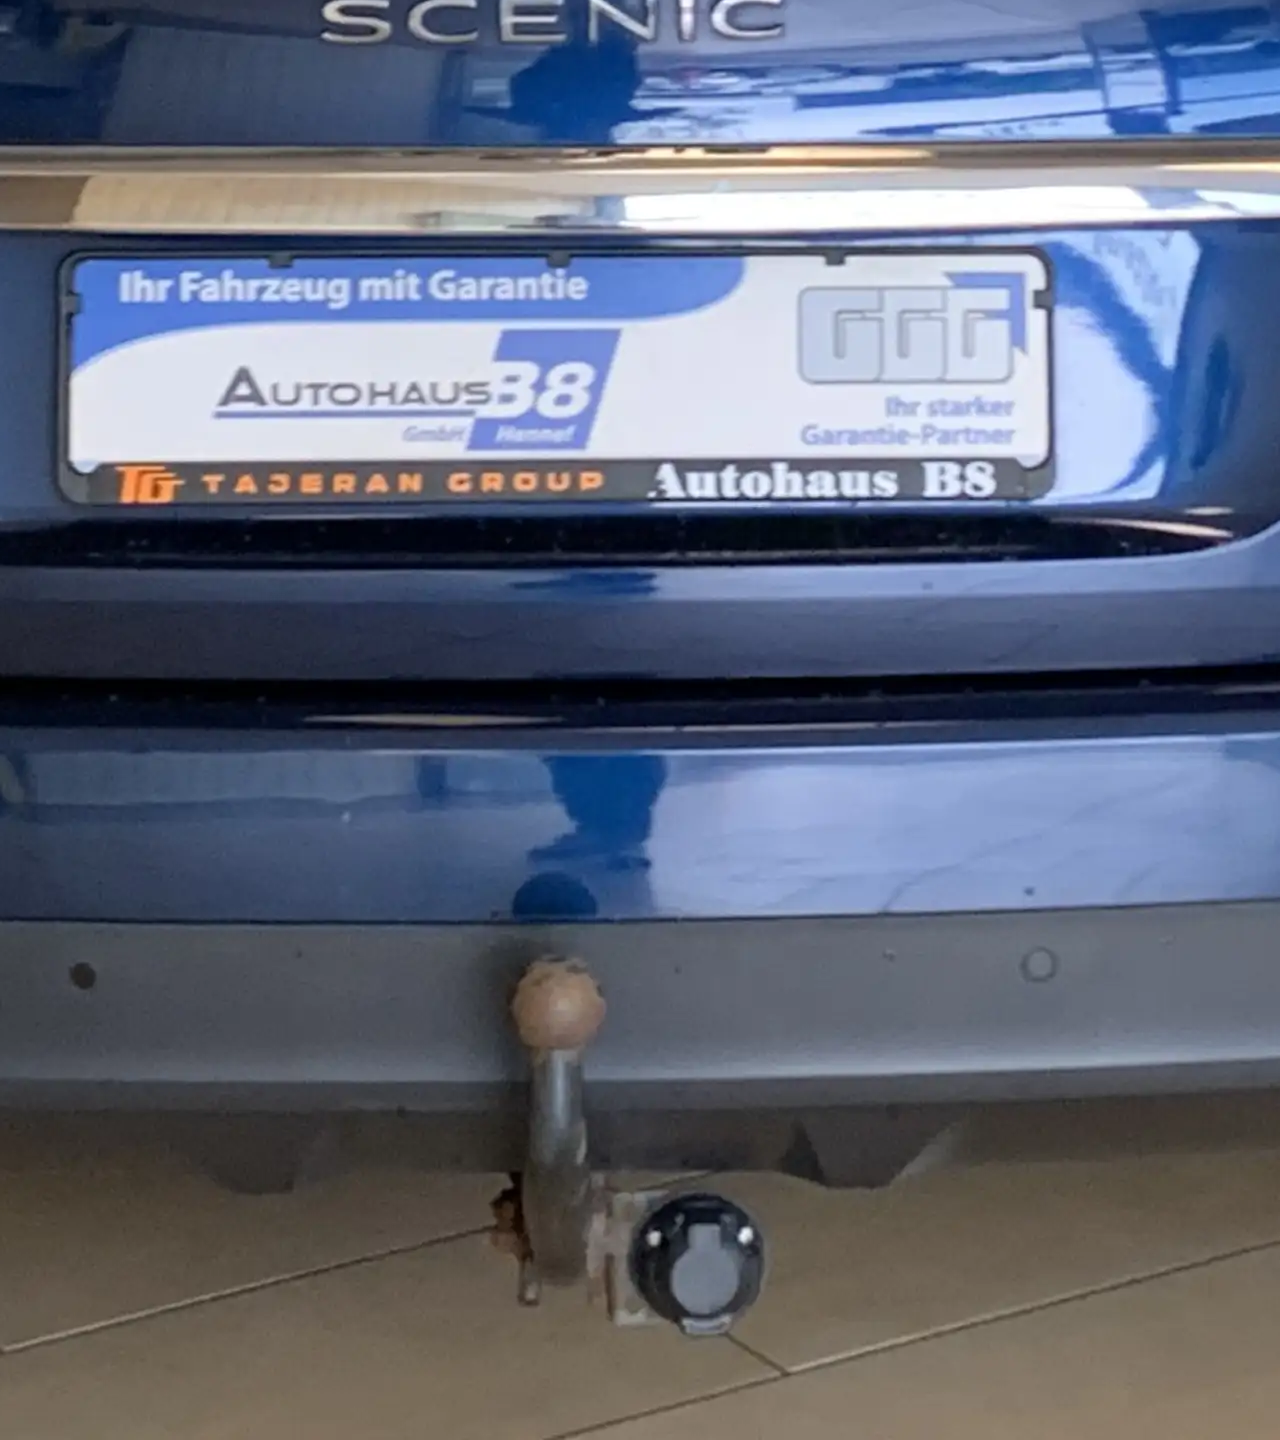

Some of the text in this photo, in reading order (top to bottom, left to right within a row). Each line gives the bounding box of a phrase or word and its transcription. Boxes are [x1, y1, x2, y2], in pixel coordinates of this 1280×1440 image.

[119, 268, 591, 310] Ihr Fahrzeug mit Garantie
[217, 365, 493, 407] AUTOHAUS
[884, 395, 1016, 418] Ihr starker
[401, 424, 469, 444] GmbH
[799, 423, 1016, 446] Garantie-Partner
[201, 471, 424, 495] TAJERAN
[446, 470, 607, 493] GROUP
[646, 460, 900, 500] Autohaus
[919, 459, 999, 500] B8
